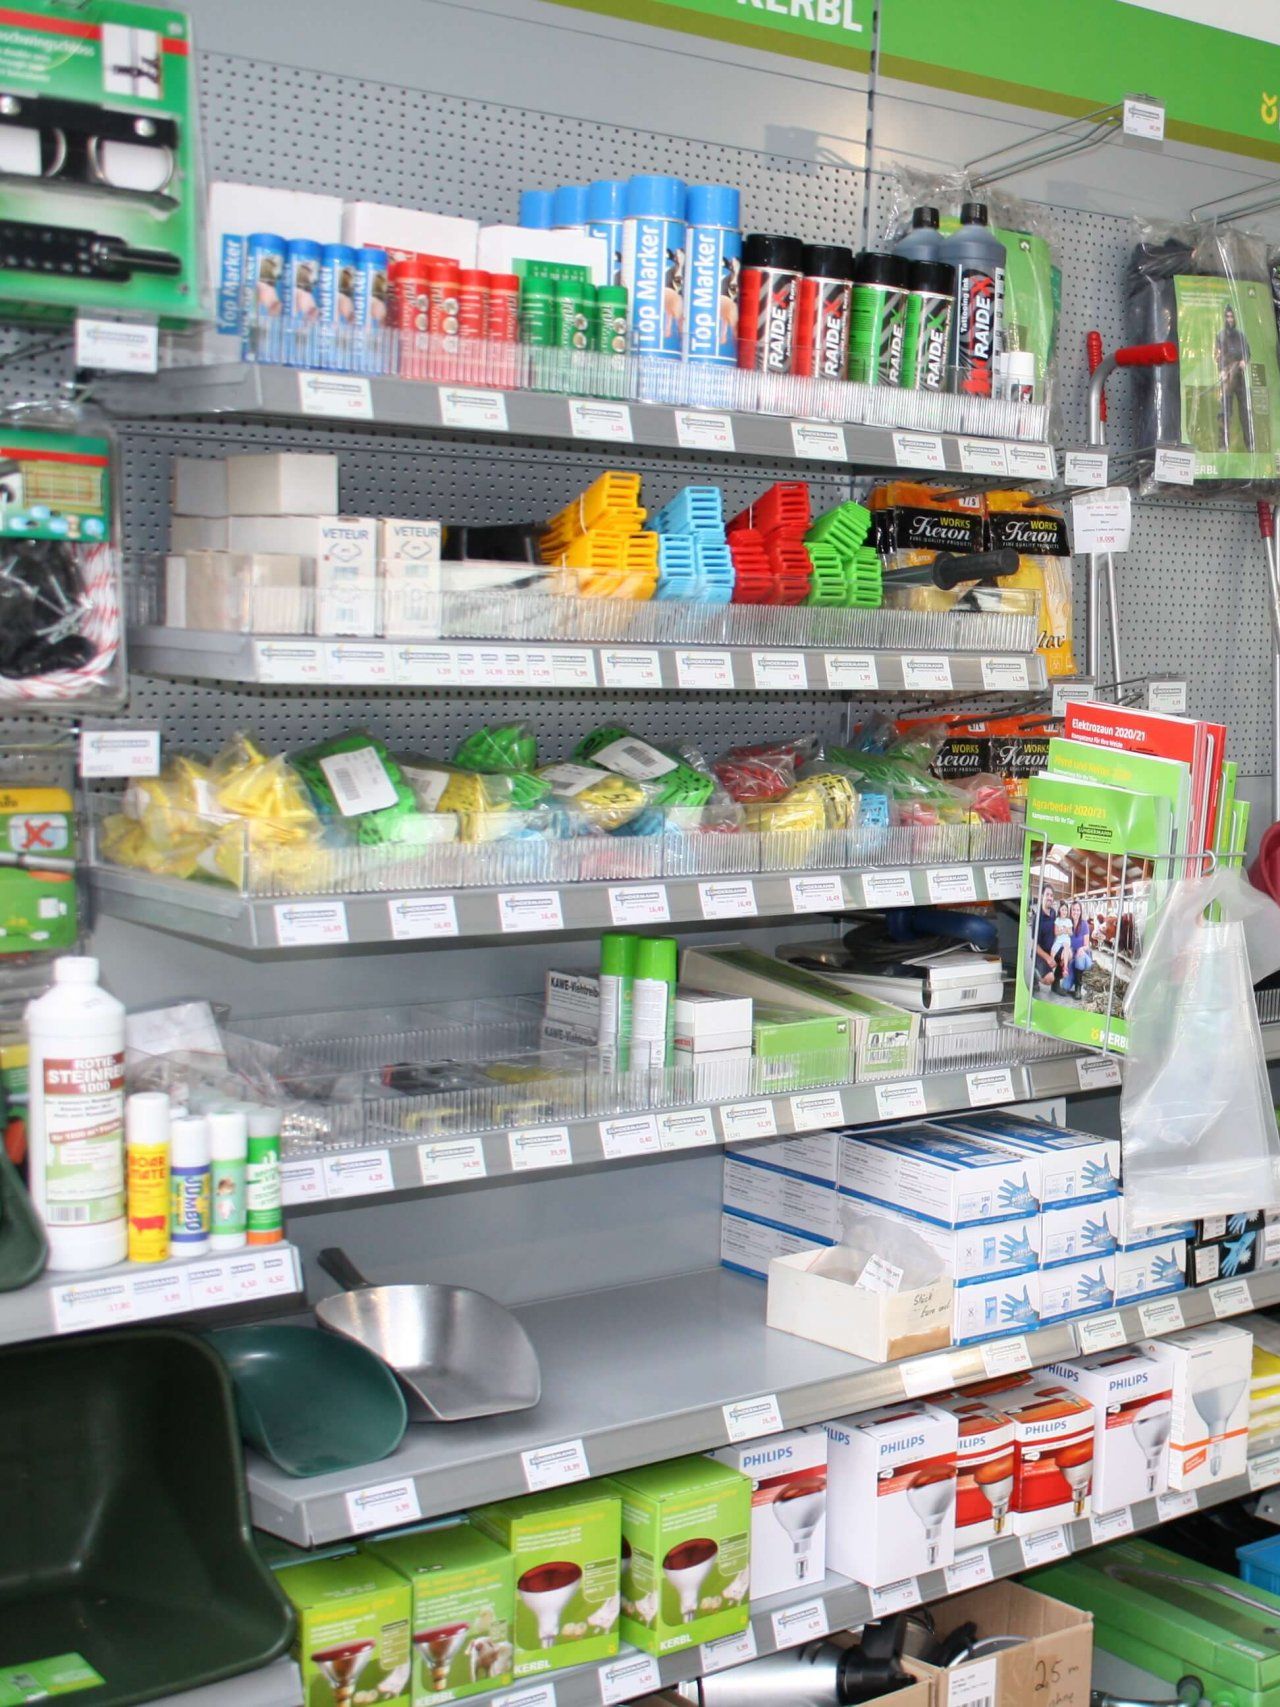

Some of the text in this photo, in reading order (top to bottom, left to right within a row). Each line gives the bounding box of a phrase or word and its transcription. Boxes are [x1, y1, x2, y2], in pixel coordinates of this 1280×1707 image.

[737, 0, 863, 32] RBL
[219, 240, 241, 331] Top Marker
[637, 224, 661, 342] Top Marker
[692, 234, 715, 351] Top Marker
[960, 290, 969, 333] Tattooing
[972, 277, 995, 360] RAIDEX
[769, 289, 791, 368] RAIDEX
[824, 300, 843, 377] RAIDEX
[927, 312, 947, 388] RAIDEX
[322, 527, 369, 541] VETEUR
[394, 526, 440, 539] VETEUR
[909, 515, 970, 540] Keron
[940, 517, 971, 529] WORKS
[1002, 521, 1057, 543] Keron
[1030, 520, 1057, 531] WORKS
[1071, 718, 1145, 741] Elektrozaun 2020/21
[951, 744, 979, 753] WORKS
[1032, 799, 1106, 819] Agrarbedarf 2020/21
[80, 1081, 110, 1093] 1000
[184, 1177, 202, 1231] JUMBO
[1109, 1372, 1148, 1391] PHILIPS
[1025, 1420, 1067, 1435] PHILIPS
[880, 1434, 925, 1456] PHILIPS
[743, 1446, 793, 1468] PHILIPS
[660, 1633, 693, 1650] KERBL
[514, 1659, 551, 1675] KERBL
[1034, 1659, 1063, 1691] 25
